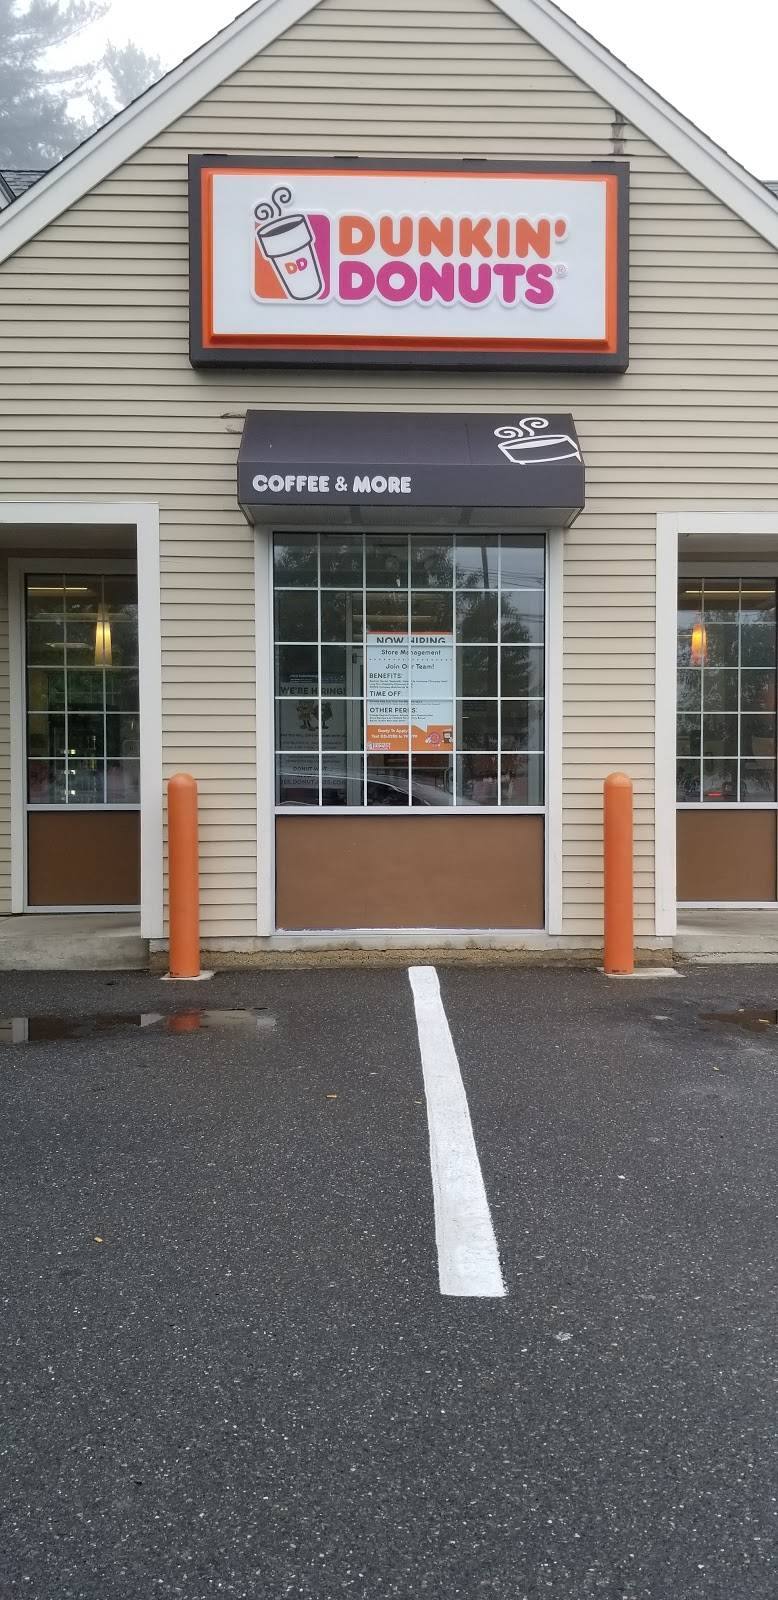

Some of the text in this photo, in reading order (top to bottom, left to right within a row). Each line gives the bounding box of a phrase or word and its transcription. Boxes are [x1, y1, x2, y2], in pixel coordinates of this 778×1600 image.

[338, 215, 566, 259] DUNKIN'
[284, 257, 308, 275] DD
[338, 260, 554, 305] DONUTS
[252, 474, 412, 494] COFFEE & MORE
[376, 636, 404, 644] NOW
[400, 649, 441, 657] Management
[311, 687, 347, 696] HRING!
